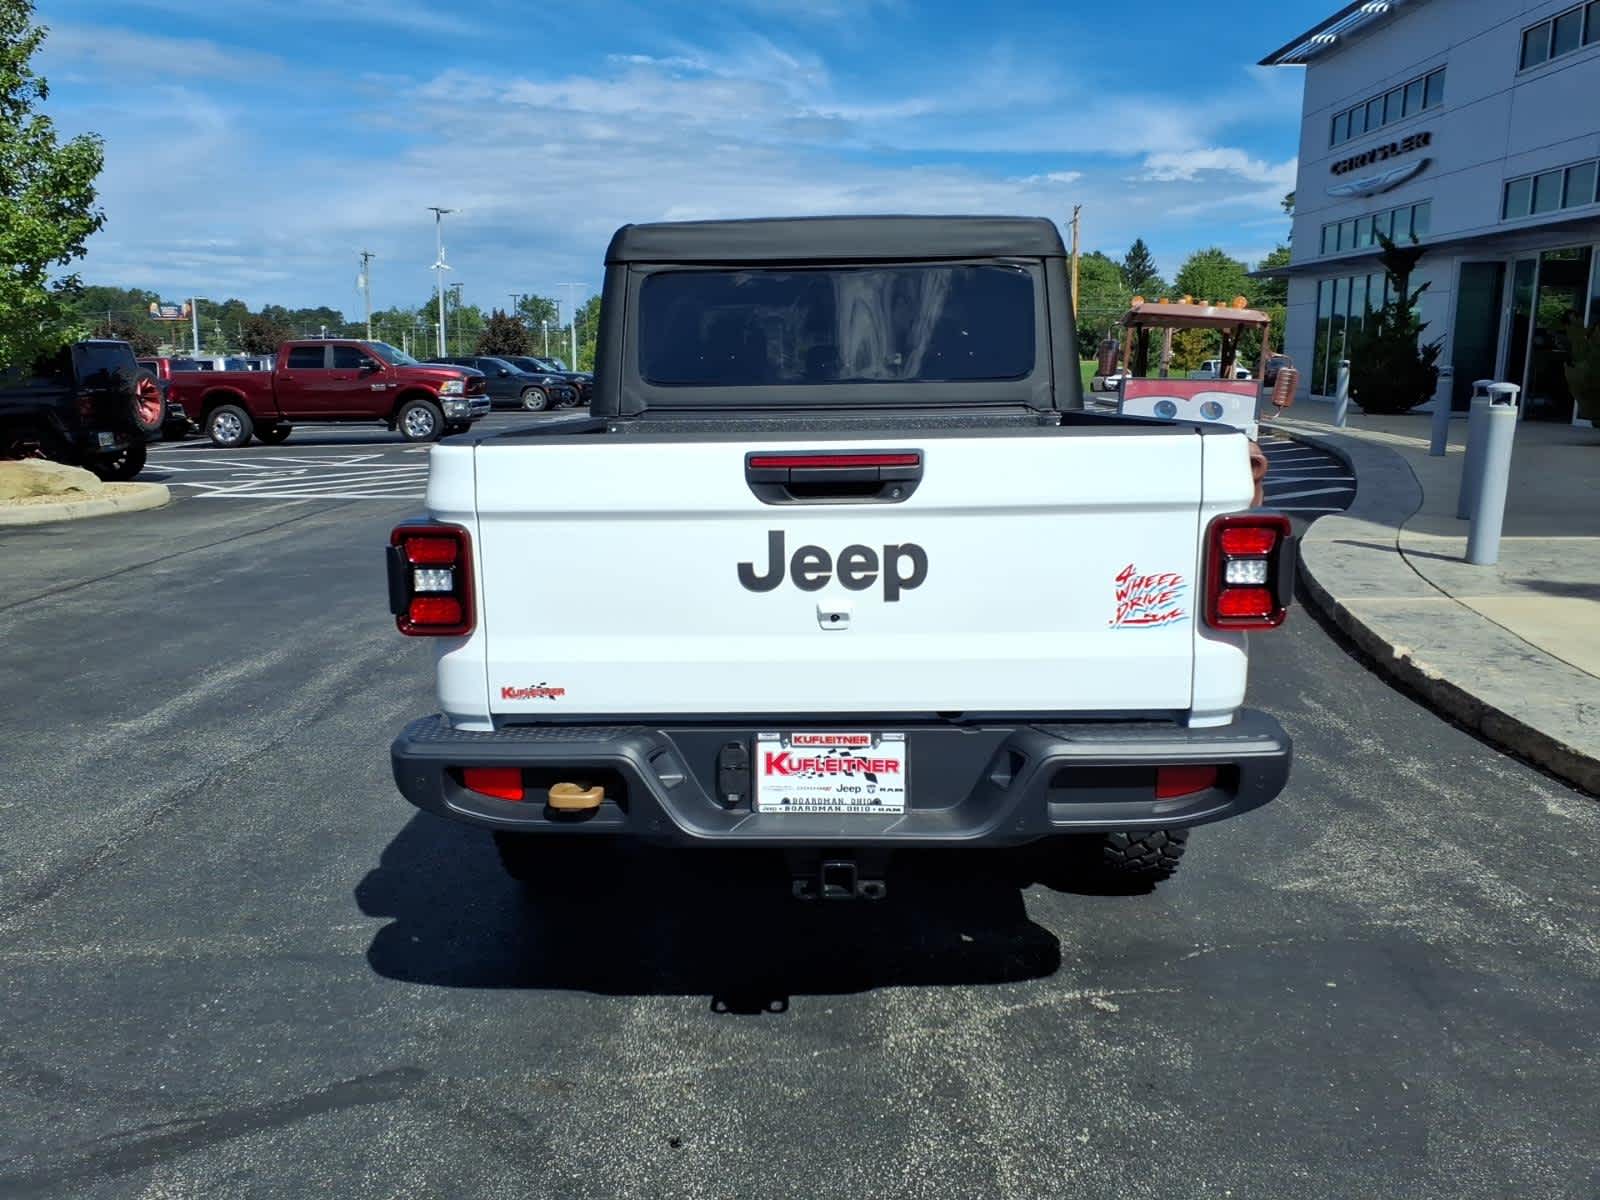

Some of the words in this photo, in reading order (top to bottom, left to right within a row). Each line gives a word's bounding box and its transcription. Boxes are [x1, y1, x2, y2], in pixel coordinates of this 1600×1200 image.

[1330, 131, 1432, 176] CHRYSLER
[737, 530, 928, 602] Jeep
[1115, 563, 1137, 585] 4
[1116, 573, 1185, 602] WHEEL
[1116, 591, 1181, 624] DRIVE
[793, 735, 869, 744] KUFLEITNER
[764, 752, 900, 776] KUFLEITNER
[836, 784, 862, 794] Jeep
[850, 797, 872, 805] OHIO
